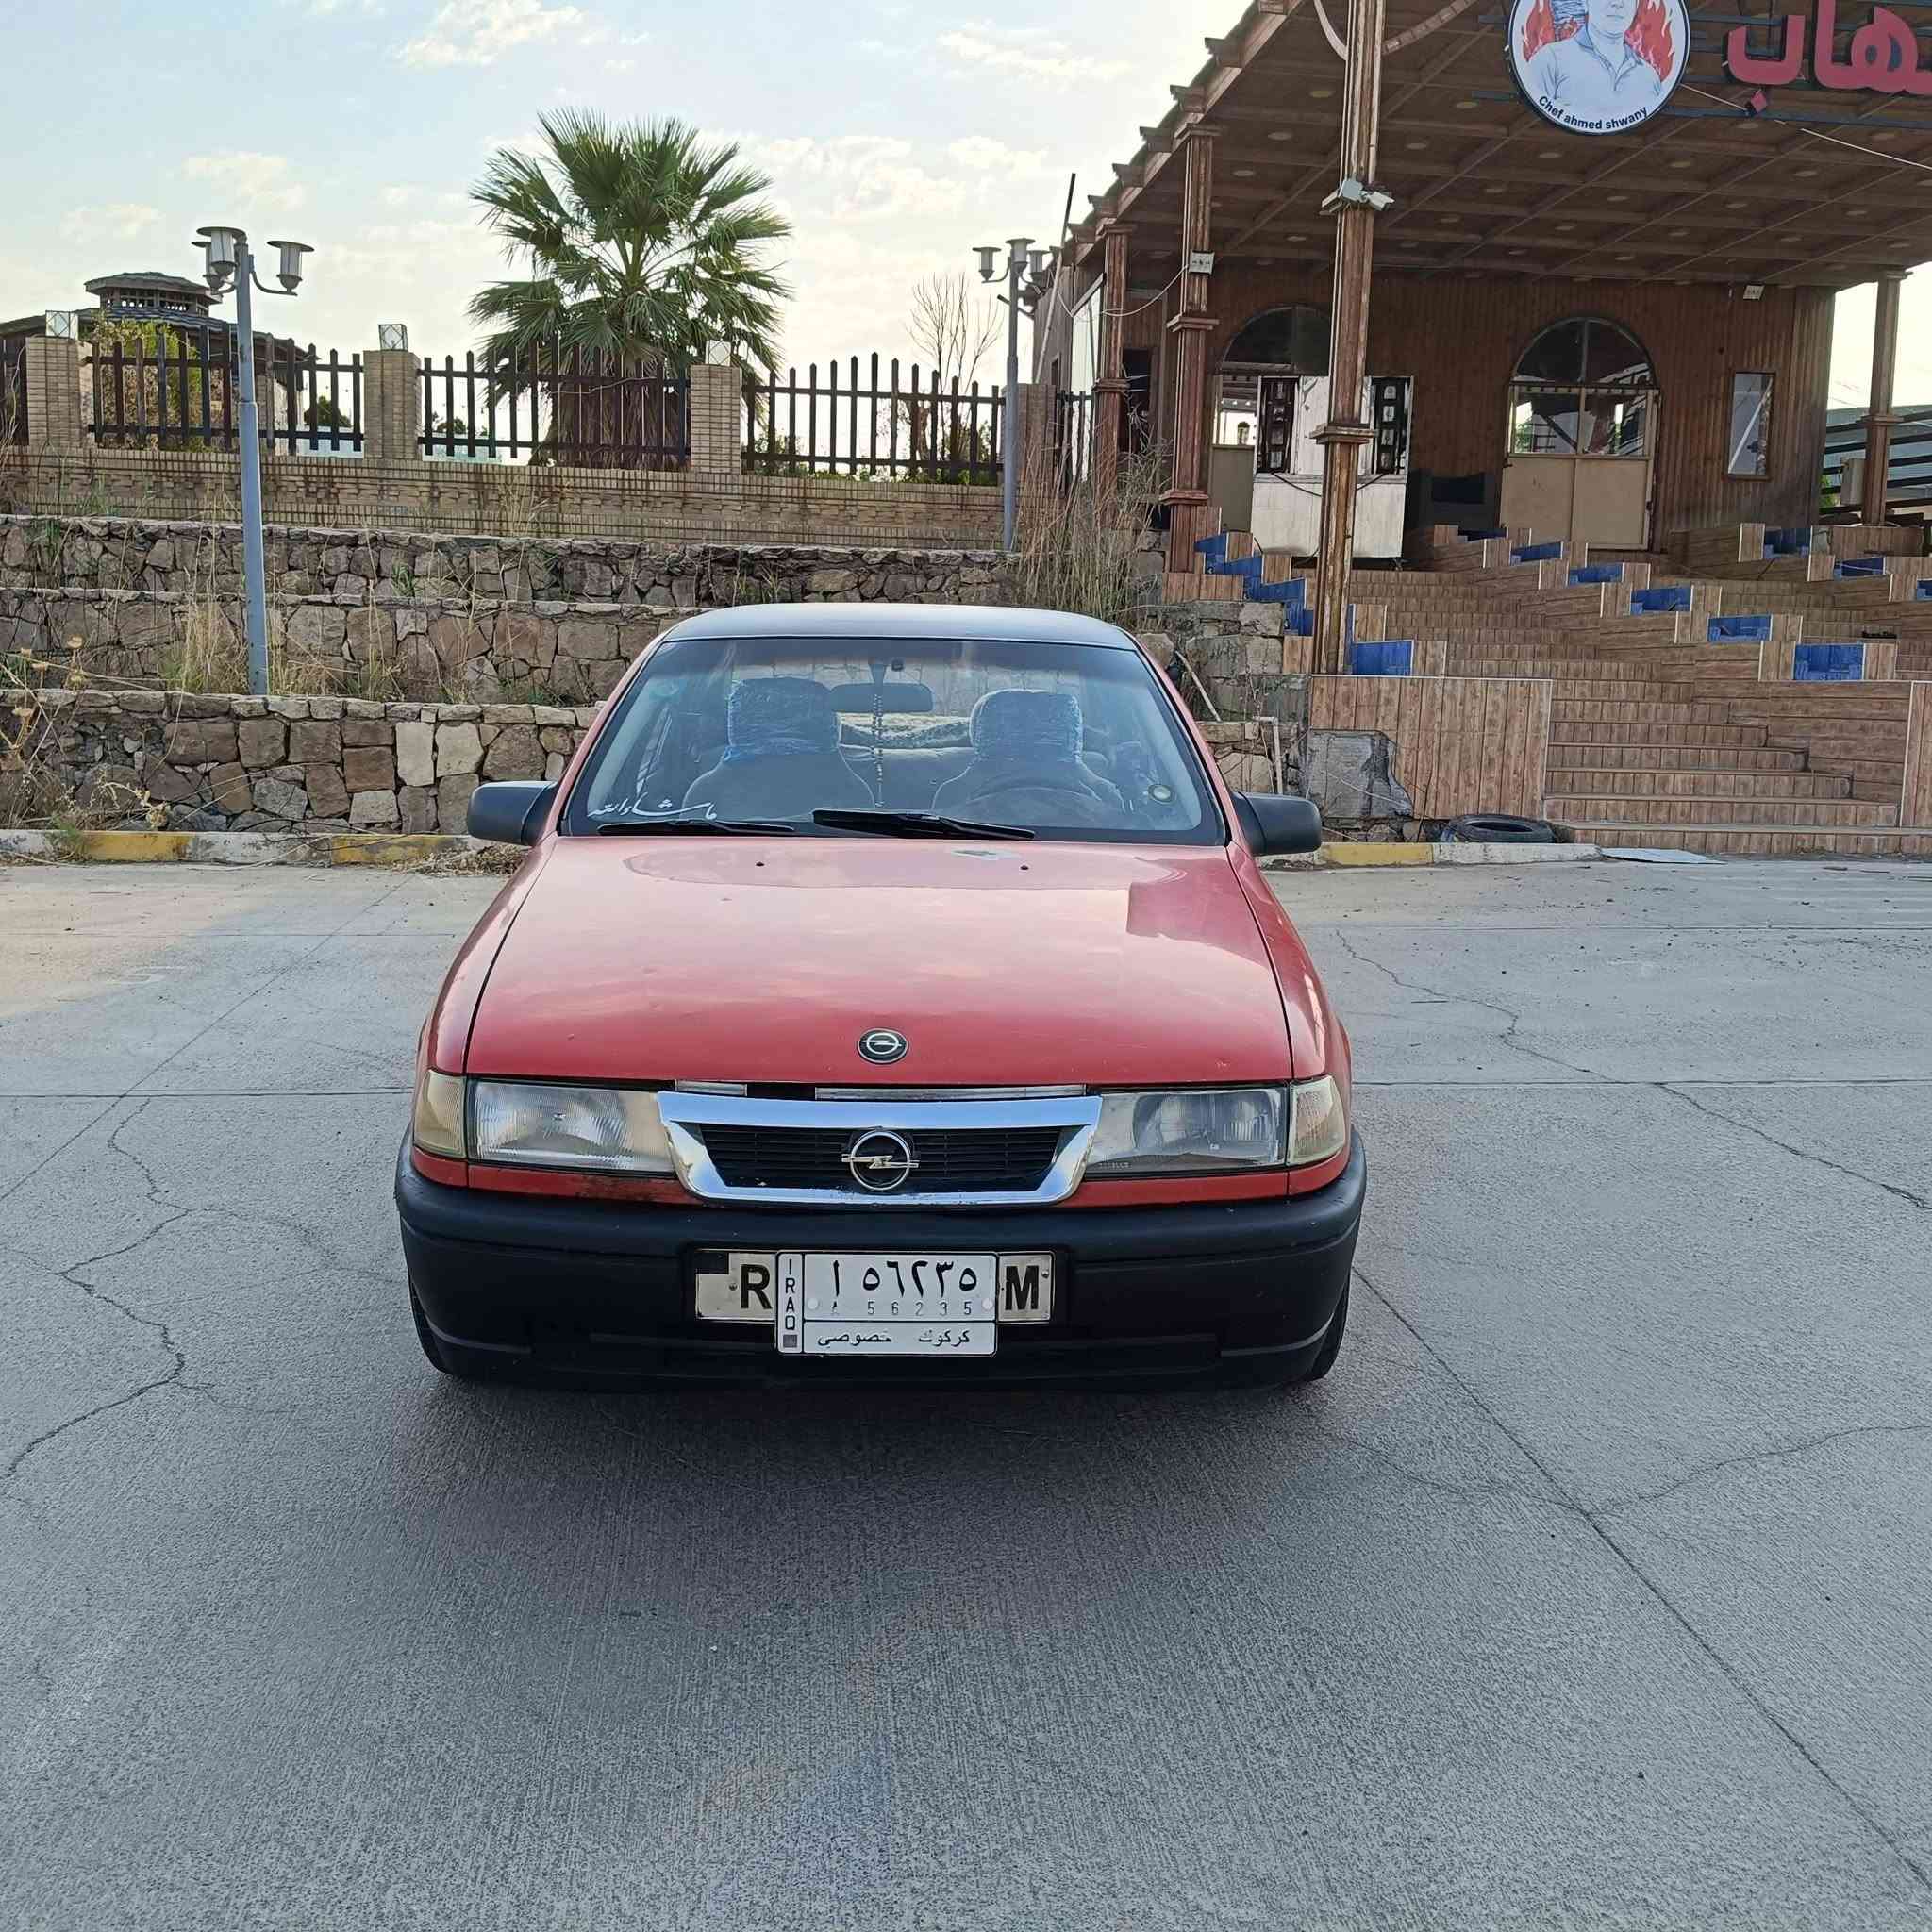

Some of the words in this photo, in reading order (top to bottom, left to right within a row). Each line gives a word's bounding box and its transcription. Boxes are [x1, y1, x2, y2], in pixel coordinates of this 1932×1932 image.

[1725, 0, 1932, 113] هاب
[1539, 96, 1564, 119] Chef
[1564, 114, 1603, 130] ahmed
[1606, 106, 1647, 129] shwany
[741, 1264, 773, 1310] R
[785, 1258, 796, 1331] IRAQ
[1005, 1265, 1039, 1311] M
